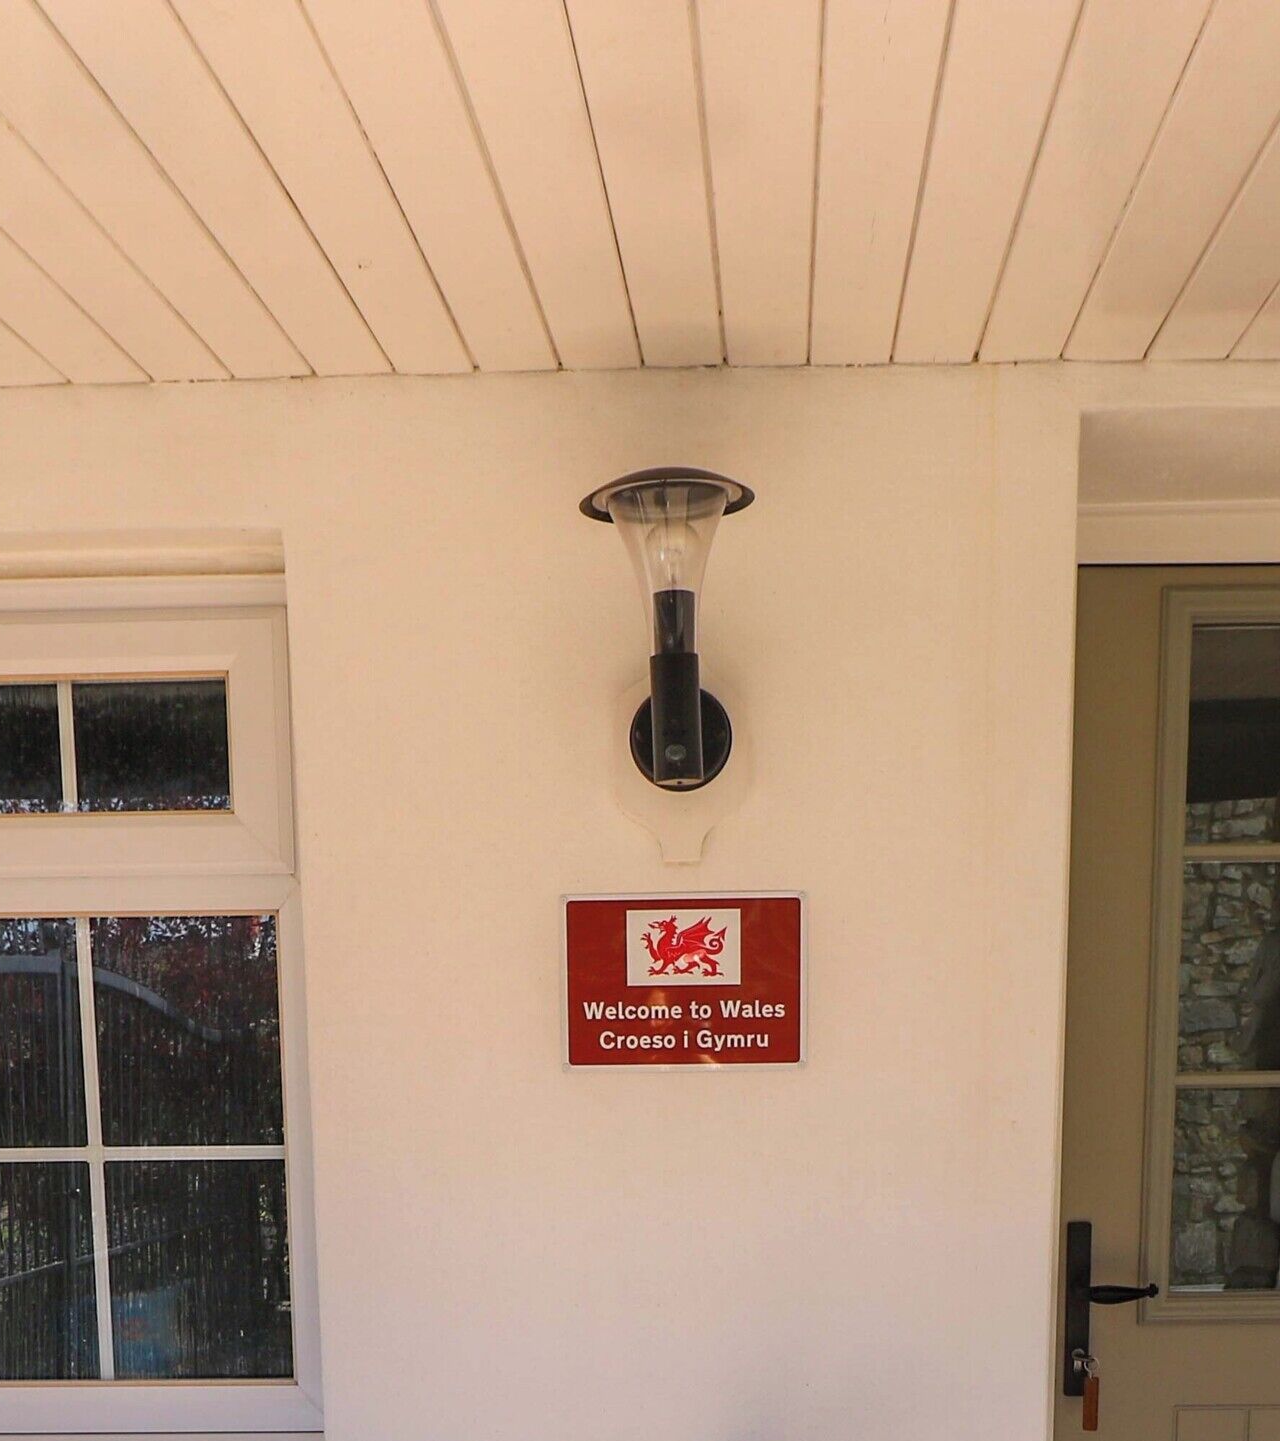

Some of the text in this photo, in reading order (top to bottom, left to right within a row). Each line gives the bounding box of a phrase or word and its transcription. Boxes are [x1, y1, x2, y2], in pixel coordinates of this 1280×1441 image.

[582, 999, 786, 1020] Welcome to Wales
[599, 1029, 769, 1051] Croeso i Gymru
